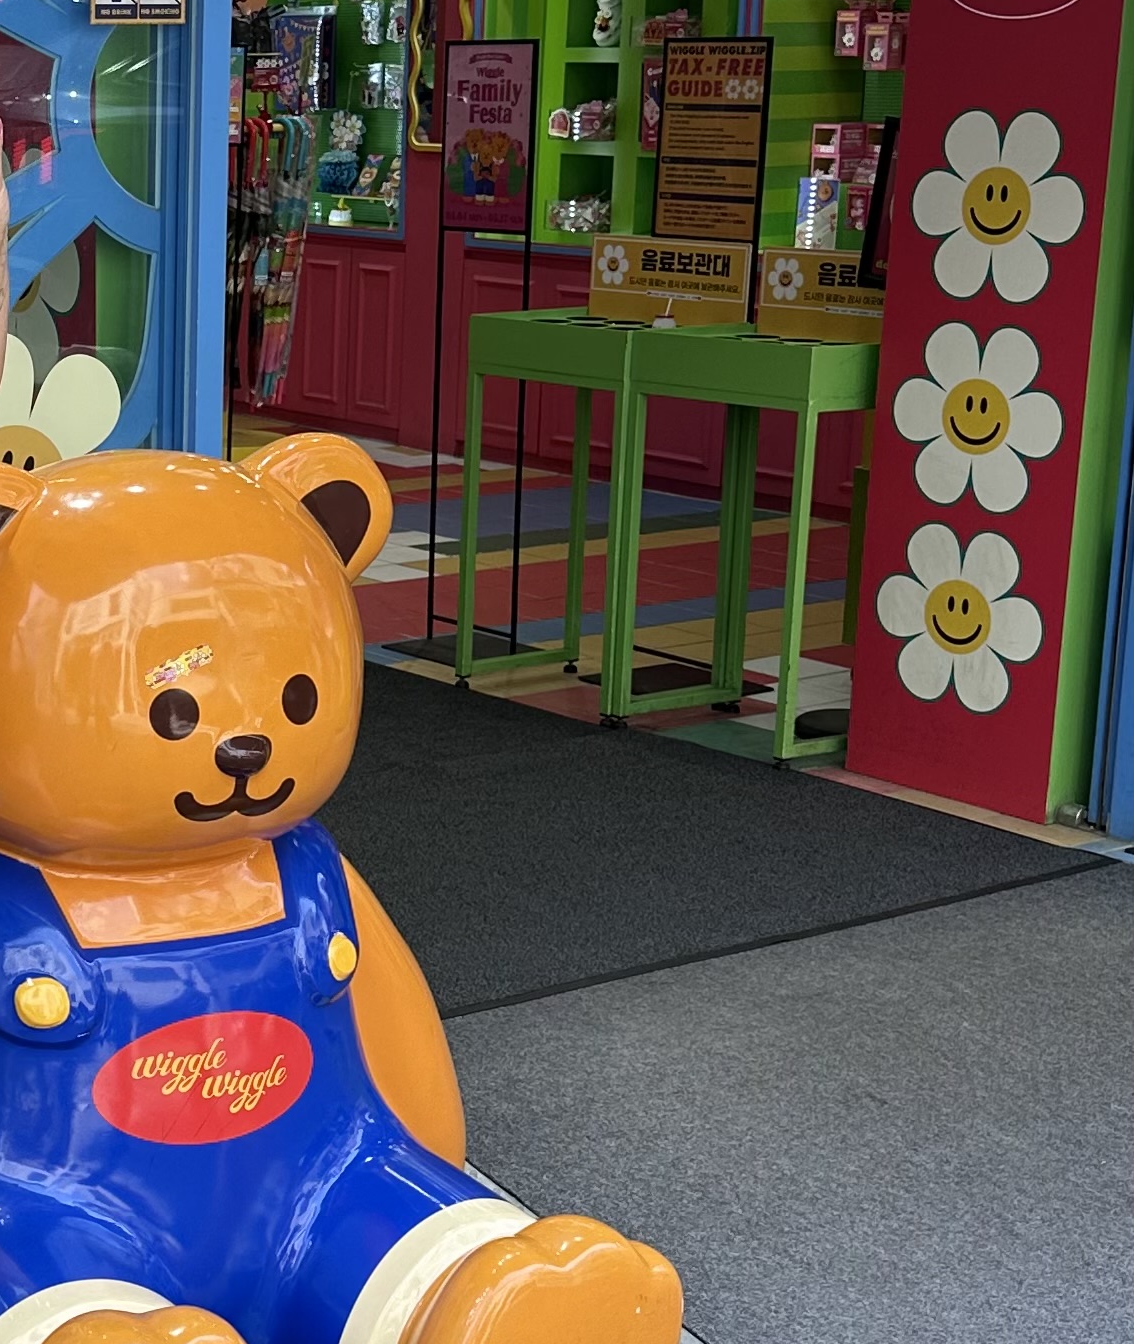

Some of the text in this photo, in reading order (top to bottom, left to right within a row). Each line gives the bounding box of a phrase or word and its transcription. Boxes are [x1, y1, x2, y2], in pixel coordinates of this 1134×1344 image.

[669, 45, 706, 55] WIGGLE
[457, 79, 523, 106] Family
[667, 79, 723, 98] GUIDE
[469, 104, 513, 124] Festa
[641, 248, 731, 278] 음료보관대
[131, 1037, 227, 1096] wiggle
[201, 1054, 288, 1114] wiggle
